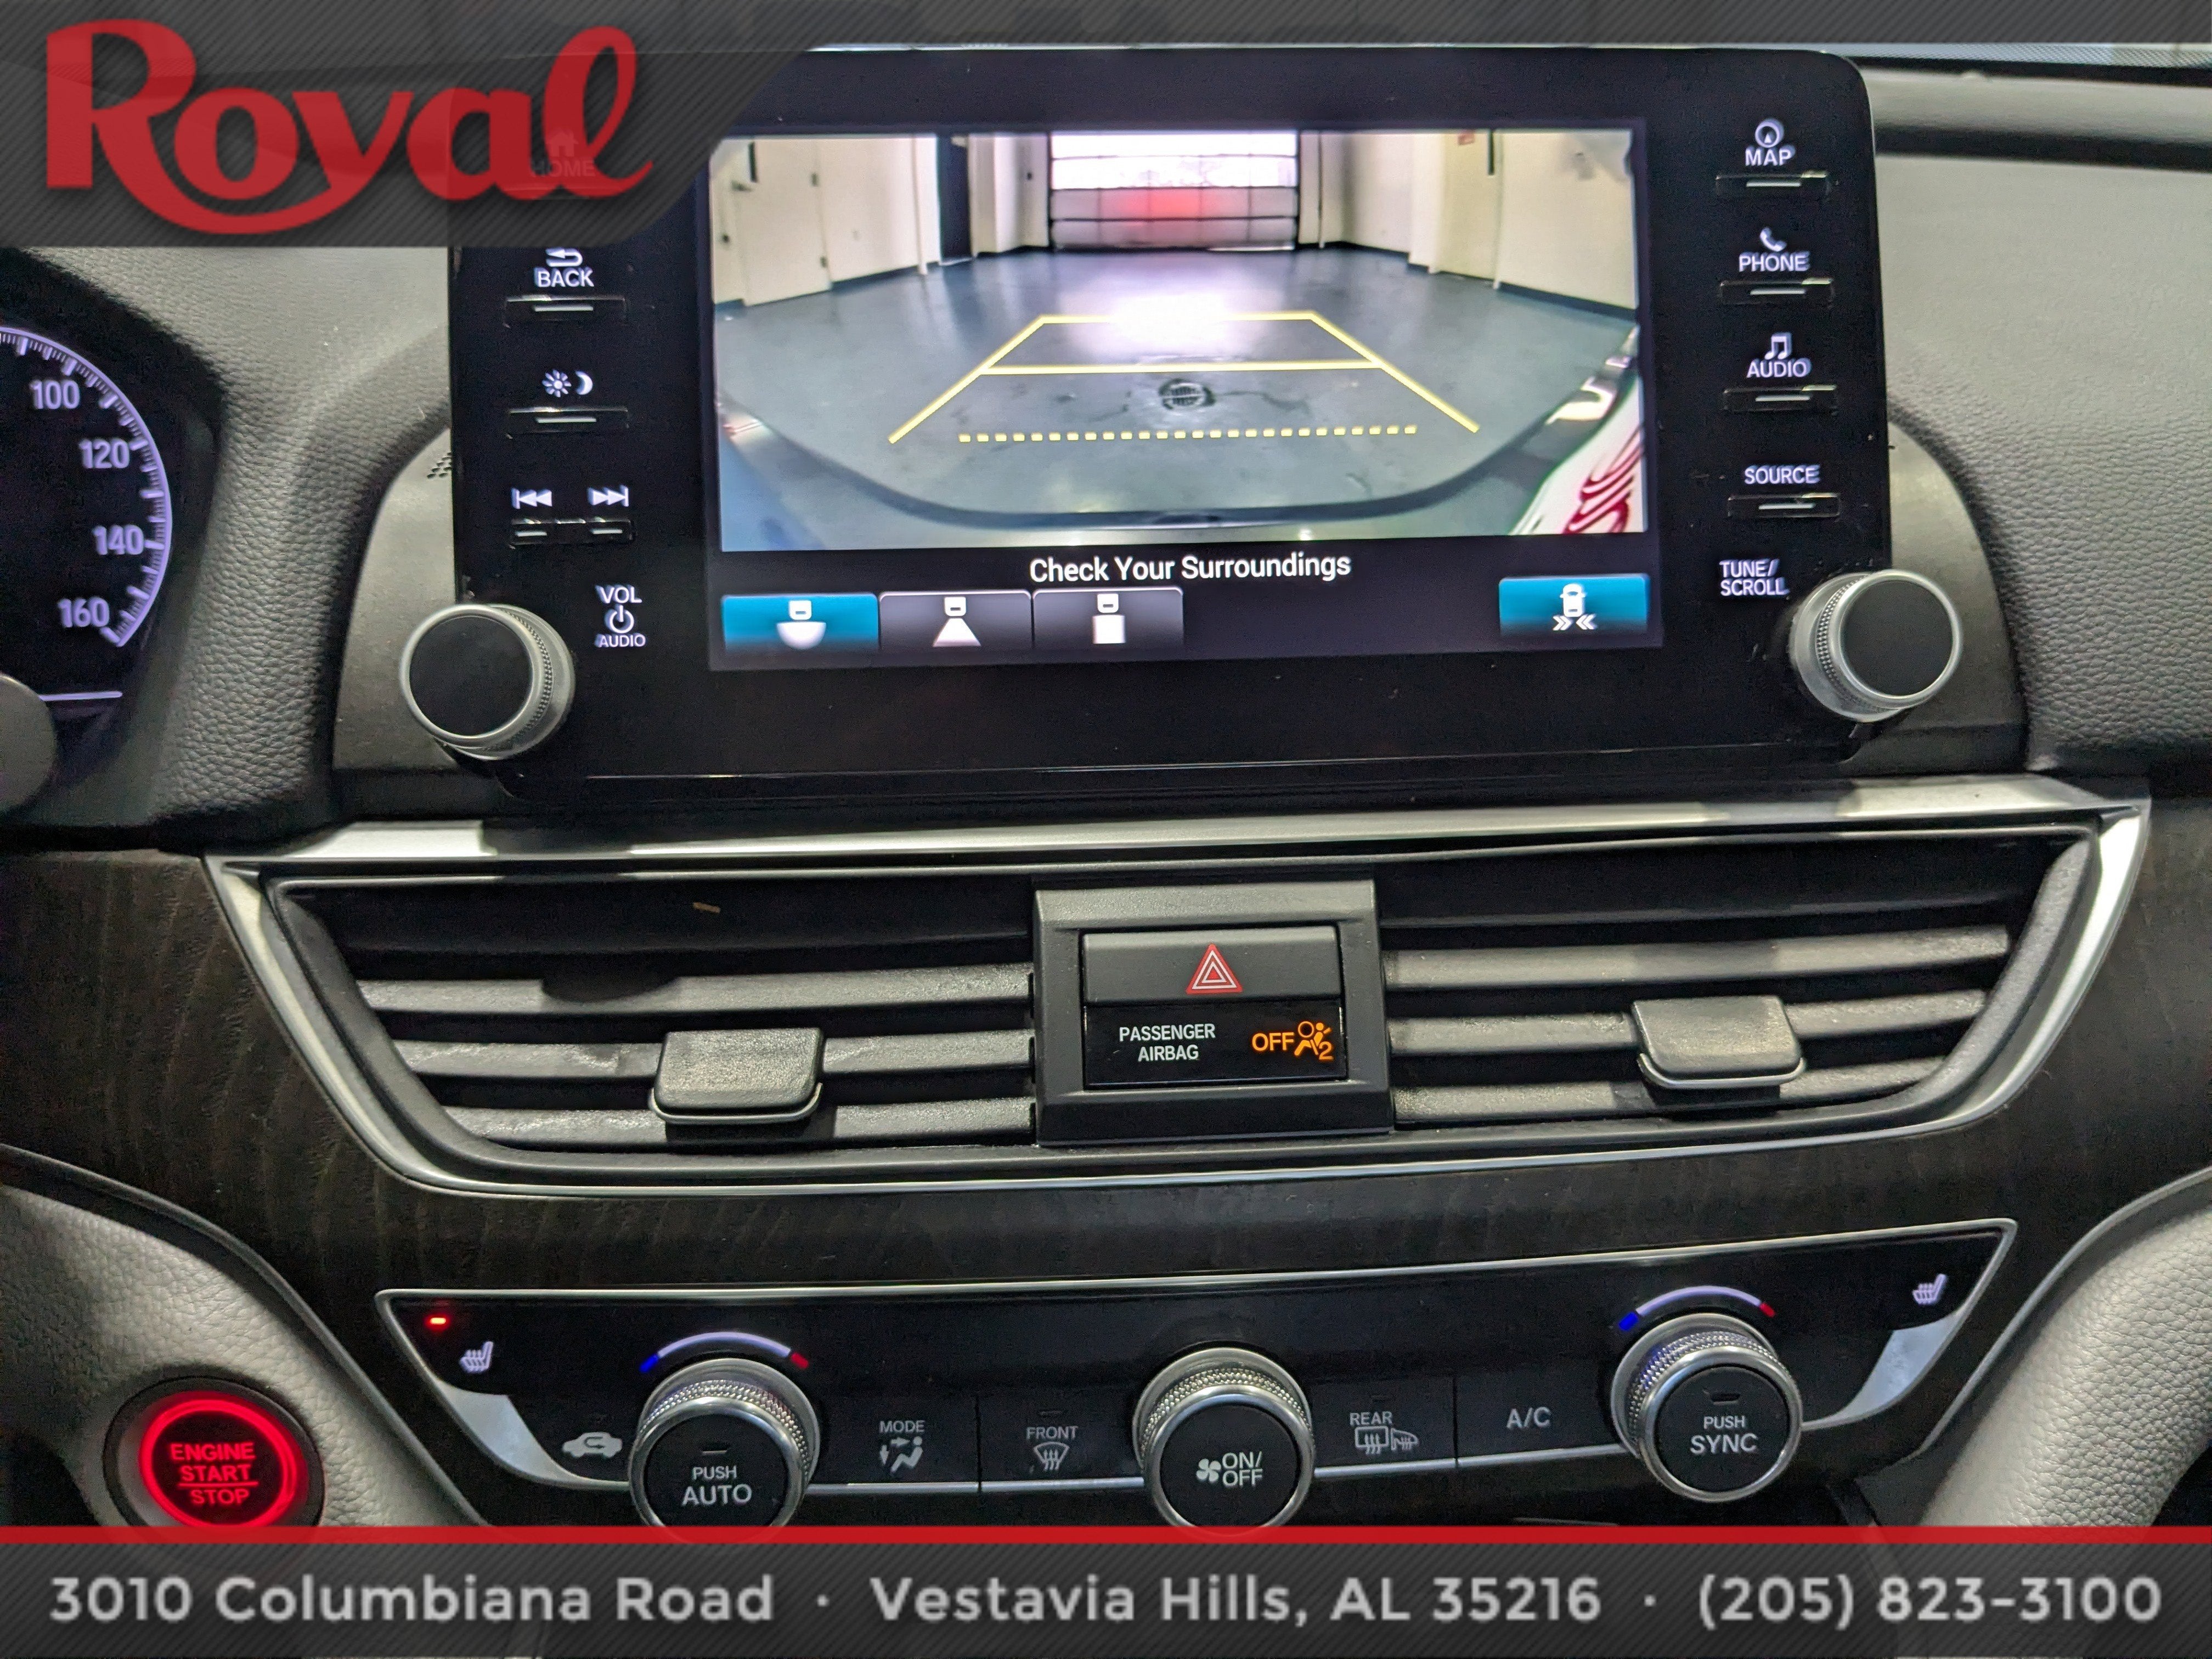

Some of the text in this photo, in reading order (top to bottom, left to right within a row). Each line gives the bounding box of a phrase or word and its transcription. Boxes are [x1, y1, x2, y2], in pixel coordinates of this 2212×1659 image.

[1745, 145, 1795, 166] MAP
[1739, 251, 1810, 272] PHONE
[534, 268, 594, 288] BACK
[1746, 358, 1812, 379] AUDIO
[30, 380, 80, 409] 100
[80, 439, 130, 469] 120
[1744, 465, 1820, 484] SOURCE
[92, 525, 145, 556] 140
[1030, 551, 1352, 583] Check Your Surroundings
[1719, 560, 1778, 577] TUNE/
[596, 585, 642, 603] VOL
[1720, 579, 1788, 596] SCROLL
[58, 597, 109, 628] 160
[596, 633, 646, 648] AUDIO
[1119, 1023, 1216, 1042] PASSENGER
[1251, 1031, 1294, 1052] OFF
[1138, 1044, 1199, 1062] AIRBAG
[880, 1420, 925, 1434] MODE
[1350, 1412, 1393, 1427] REAR
[1506, 1407, 1551, 1429] A/C
[1703, 1415, 1746, 1430] PUSH
[1026, 1426, 1077, 1440] FRONT
[170, 1443, 256, 1460] ENGINE
[1690, 1433, 1758, 1454] SYNC
[1222, 1451, 1263, 1469] ON/
[180, 1464, 250, 1481] START
[692, 1465, 737, 1481] PUSH
[1222, 1470, 1263, 1487] OFF
[191, 1489, 250, 1504] STOP
[682, 1485, 752, 1506] AUTO
